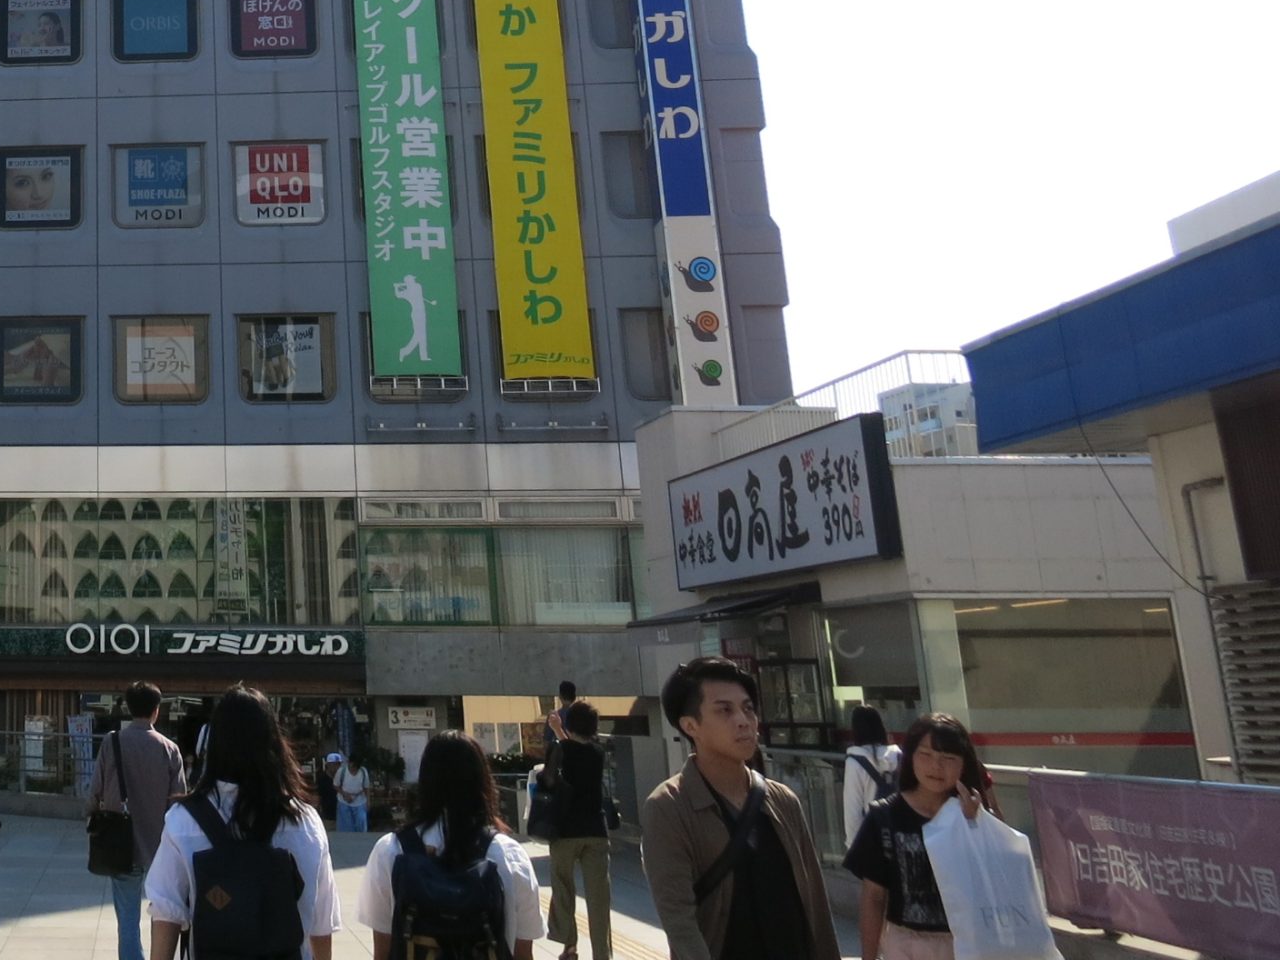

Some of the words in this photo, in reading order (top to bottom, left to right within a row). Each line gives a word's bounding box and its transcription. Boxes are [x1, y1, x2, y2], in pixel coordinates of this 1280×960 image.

[130, 16, 181, 31] ORBIS
[253, 36, 295, 47] MODI
[134, 158, 155, 179] 靴
[255, 153, 298, 172] UNI
[256, 176, 303, 200] QLO
[504, 62, 563, 326] ファミリかしわ
[135, 209, 182, 221] MODI
[257, 206, 305, 218] MODI
[143, 346, 176, 360] エース
[506, 352, 591, 366] ファミリかしわ
[131, 360, 191, 374] コンタクト
[806, 447, 861, 502] 中華そば
[718, 454, 810, 563] 日高屋
[678, 528, 717, 570] 中華食堂
[167, 632, 349, 656] ファミリかしわ
[1069, 838, 1280, 917] 旧吉田家住宅歴史公園
